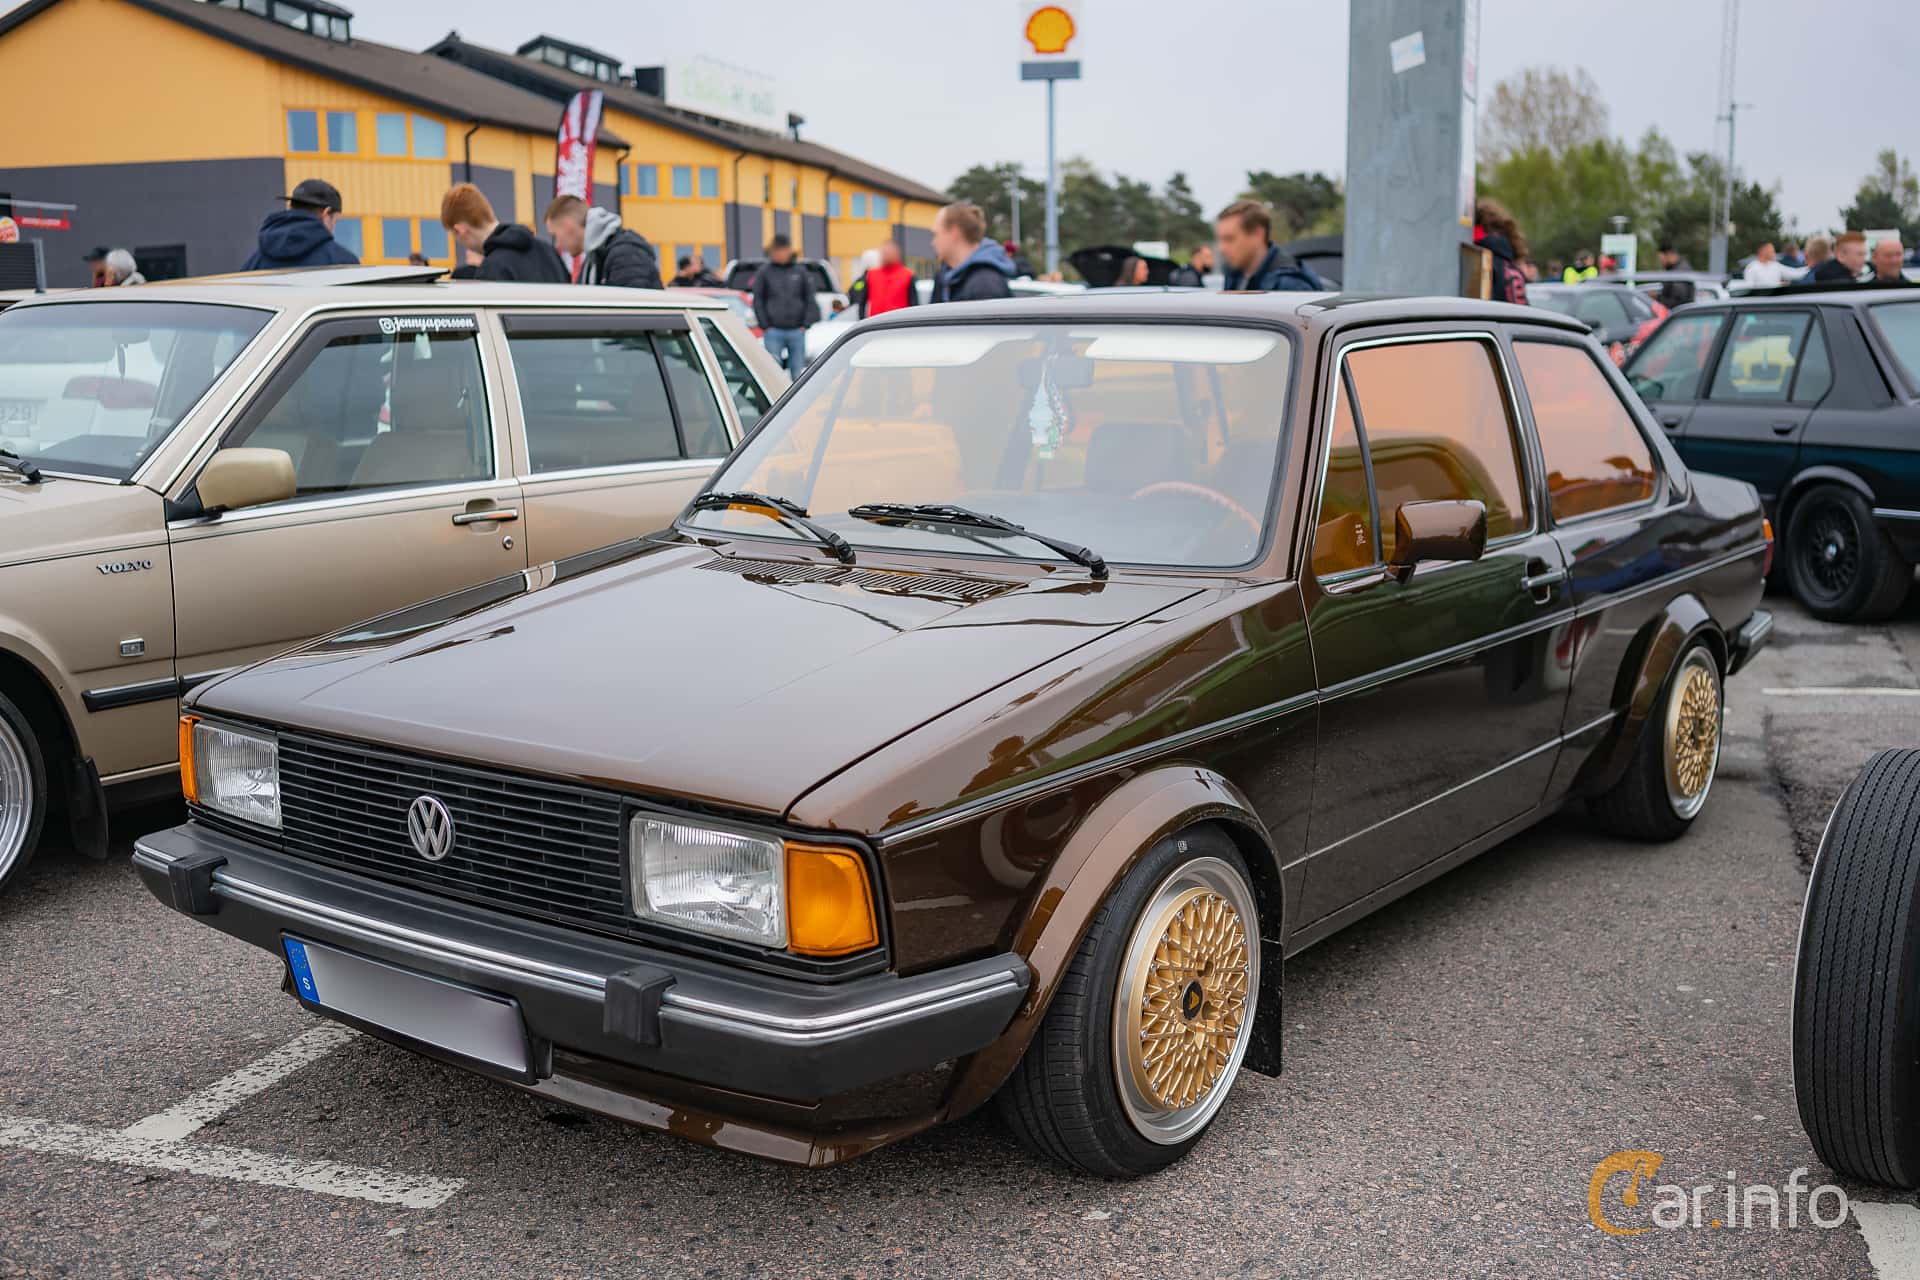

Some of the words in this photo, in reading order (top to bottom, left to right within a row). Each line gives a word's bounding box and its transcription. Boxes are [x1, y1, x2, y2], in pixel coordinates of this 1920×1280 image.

[96, 559, 153, 575] VOLVO
[408, 796, 453, 861] VW
[302, 976, 311, 991] S
